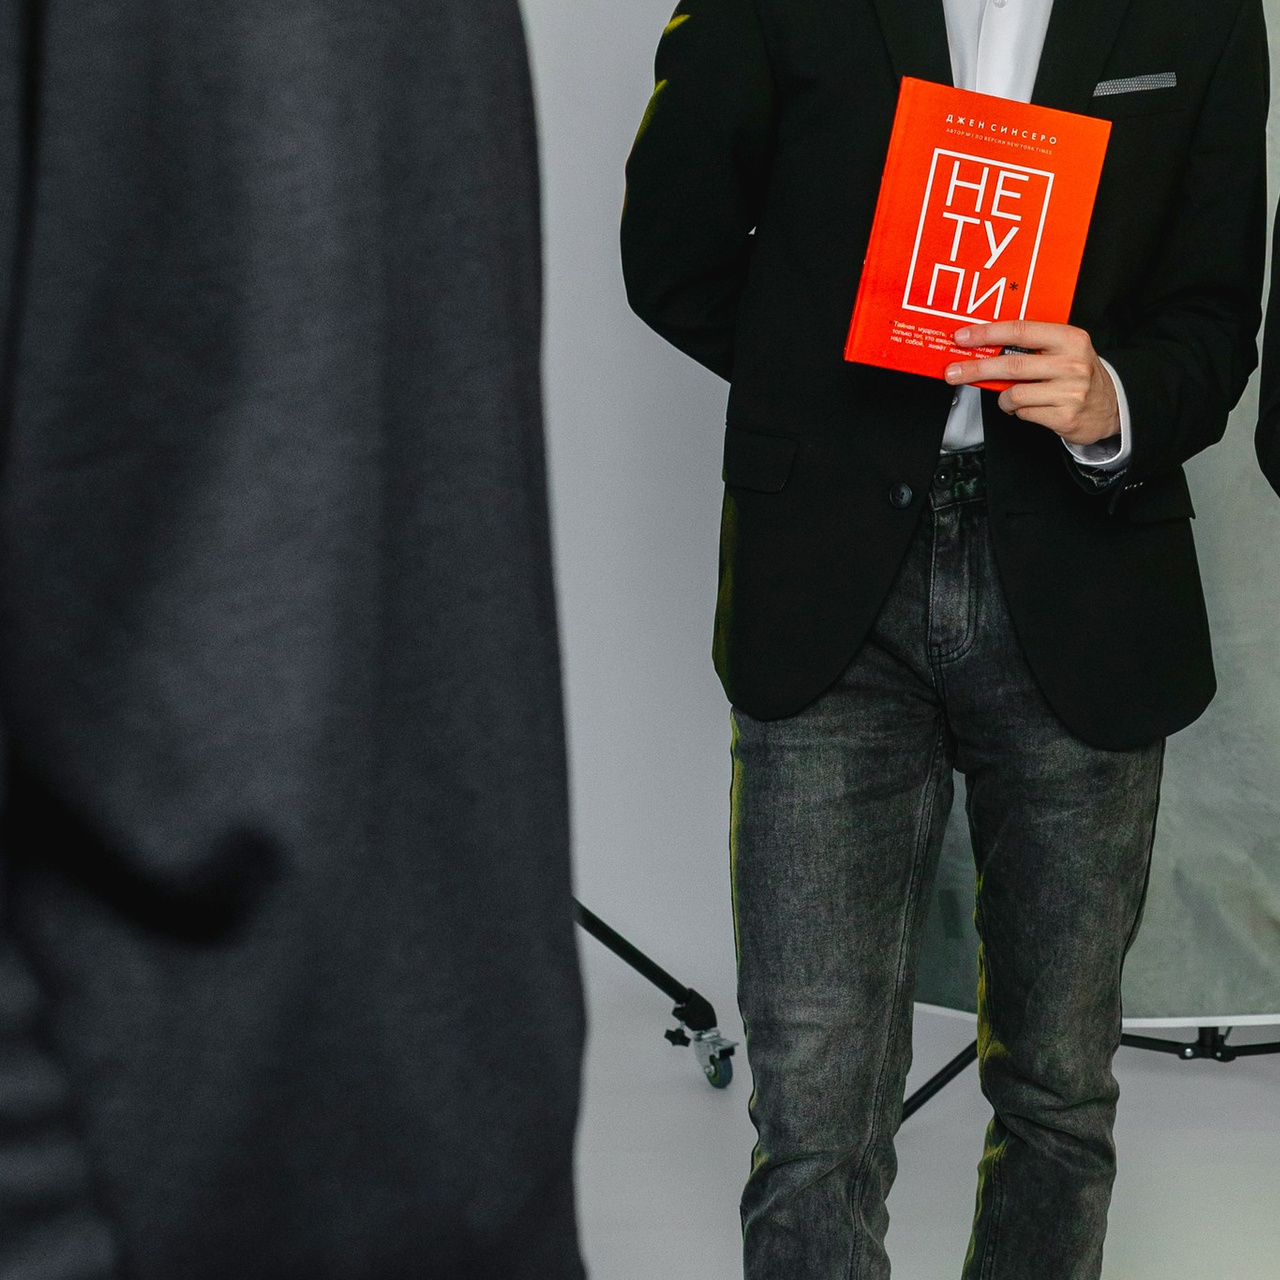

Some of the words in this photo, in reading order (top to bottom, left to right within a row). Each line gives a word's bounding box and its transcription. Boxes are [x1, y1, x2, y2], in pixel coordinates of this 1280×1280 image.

[946, 114, 985, 129] ДЖЕН
[990, 124, 1057, 145] СИНСЕРО
[945, 160, 1030, 221] НЕ
